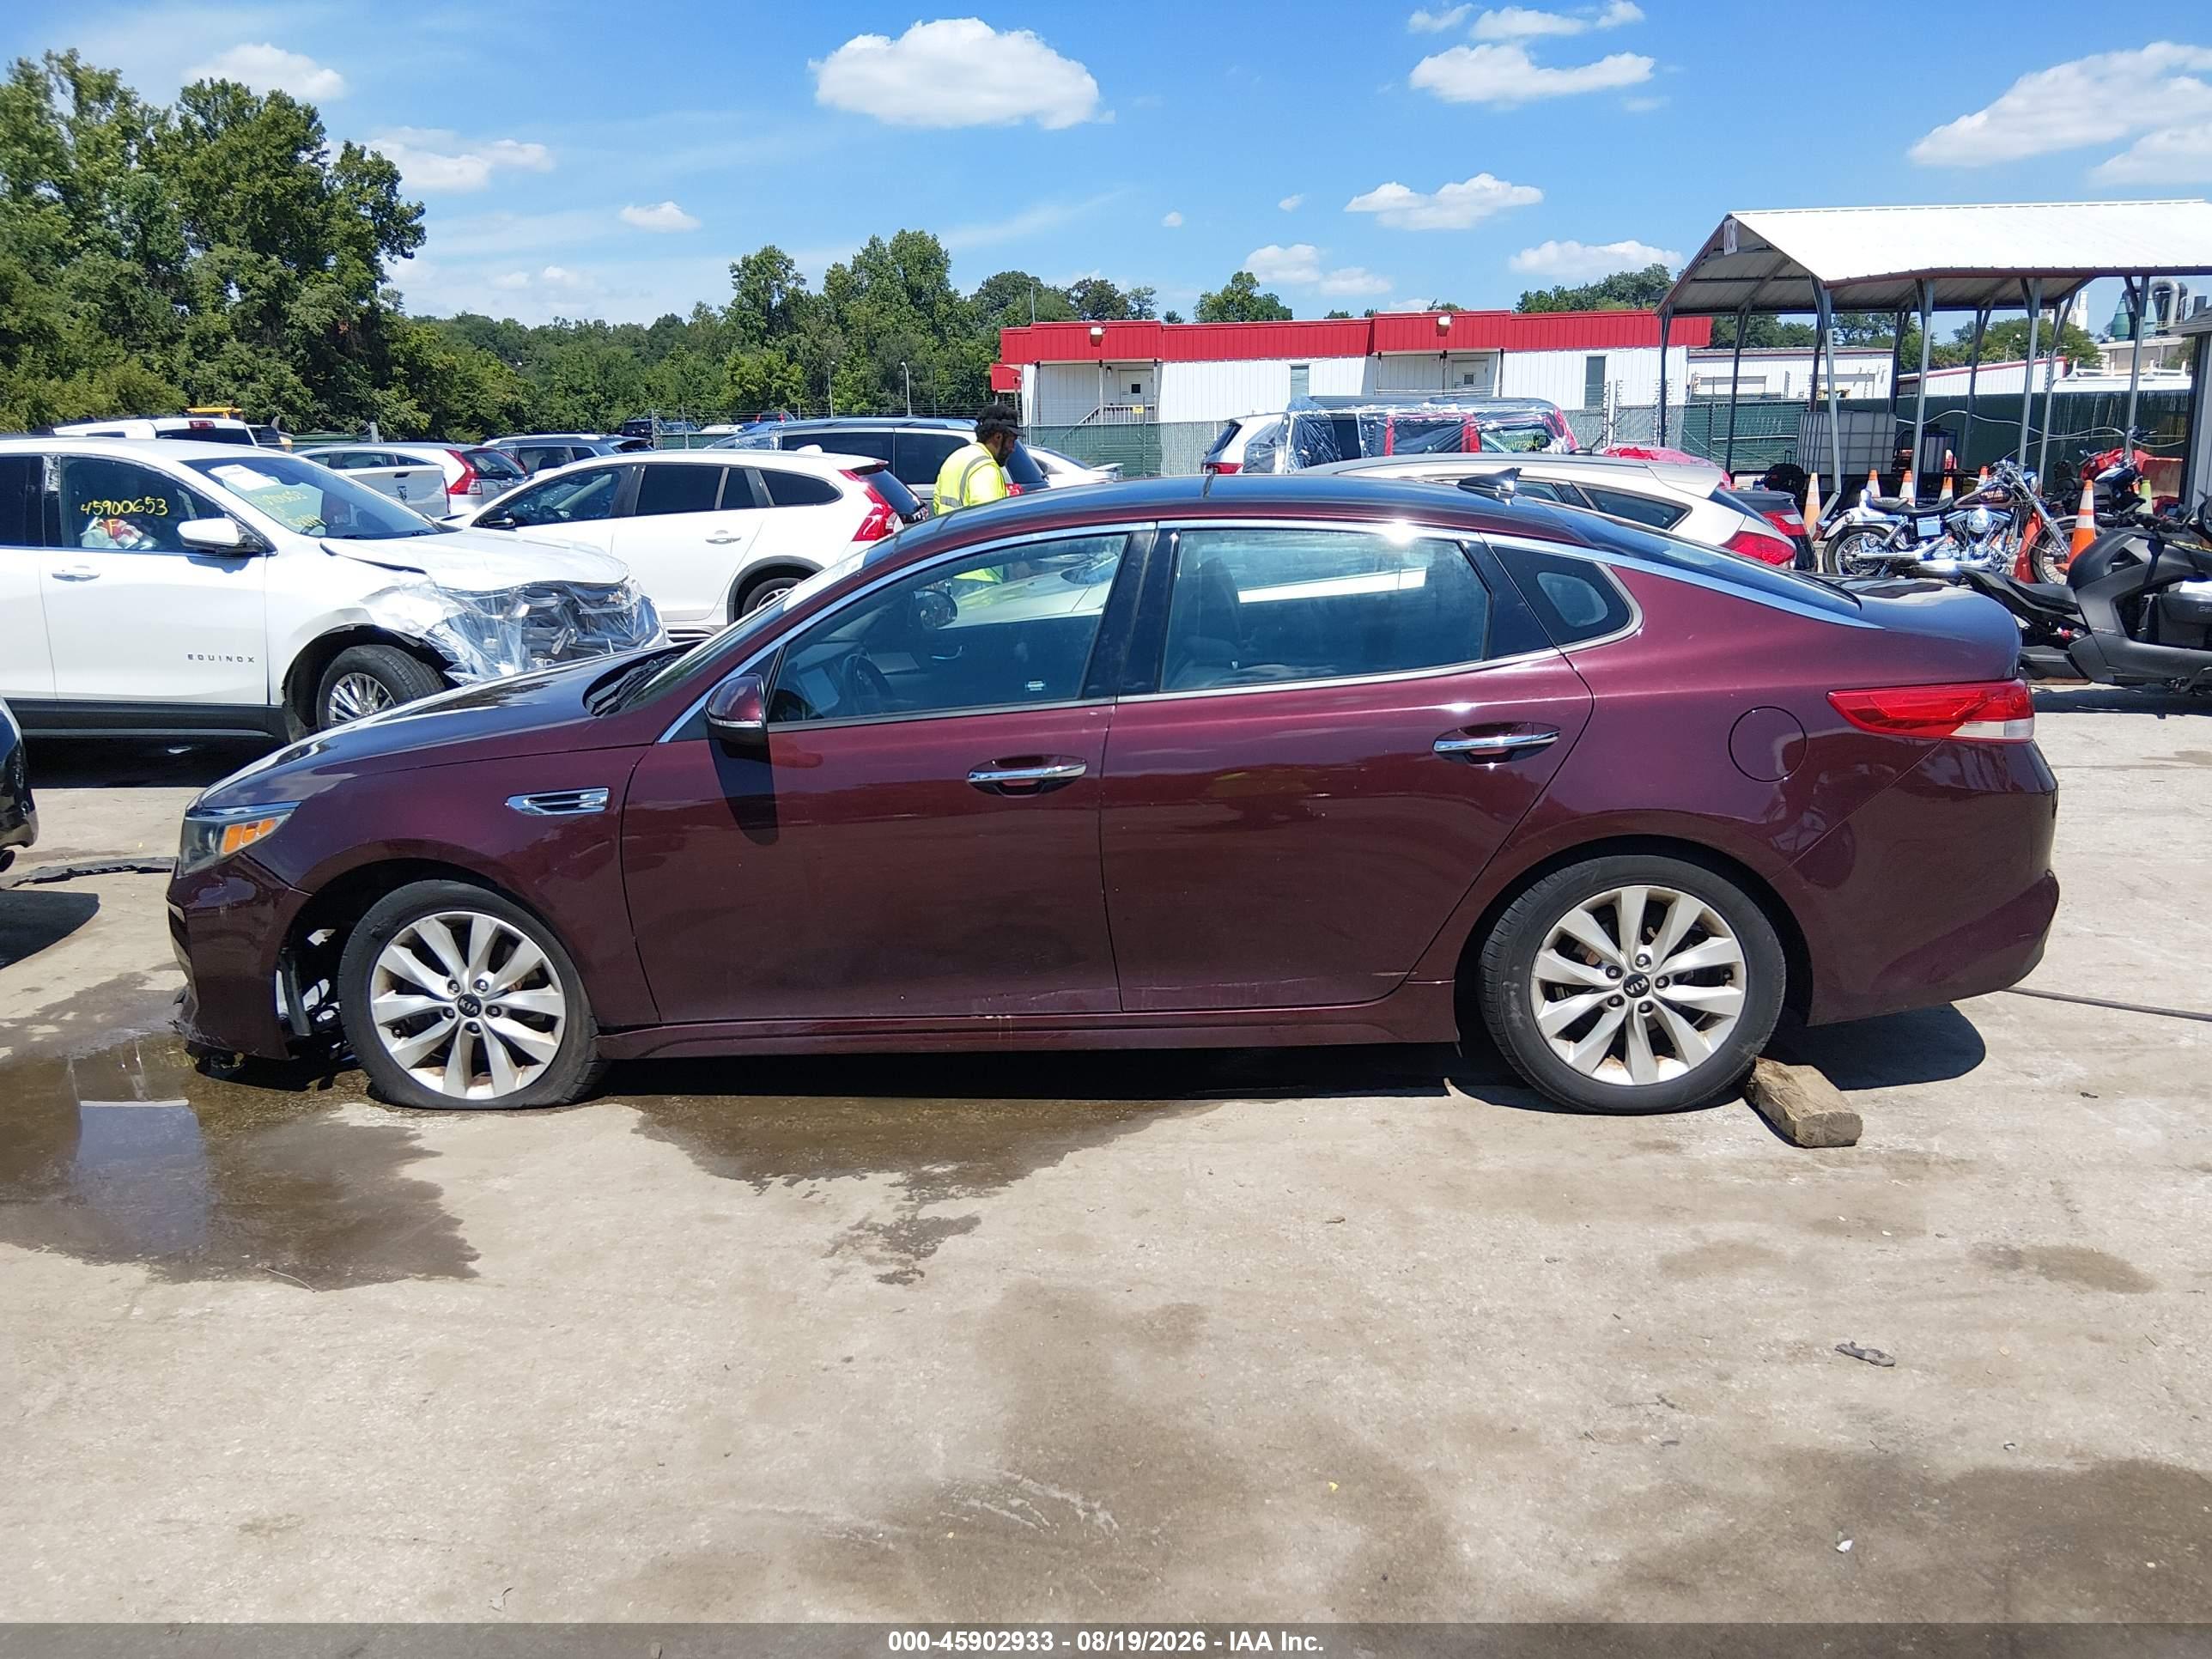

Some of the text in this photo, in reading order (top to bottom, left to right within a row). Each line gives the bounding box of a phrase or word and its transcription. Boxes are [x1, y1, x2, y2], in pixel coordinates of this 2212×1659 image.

[80, 495, 168, 516] 45900653
[106, 519, 119, 537] F
[187, 653, 255, 664] EQUINOX
[1626, 978, 1649, 994] KIA
[459, 998, 478, 1014] KIA
